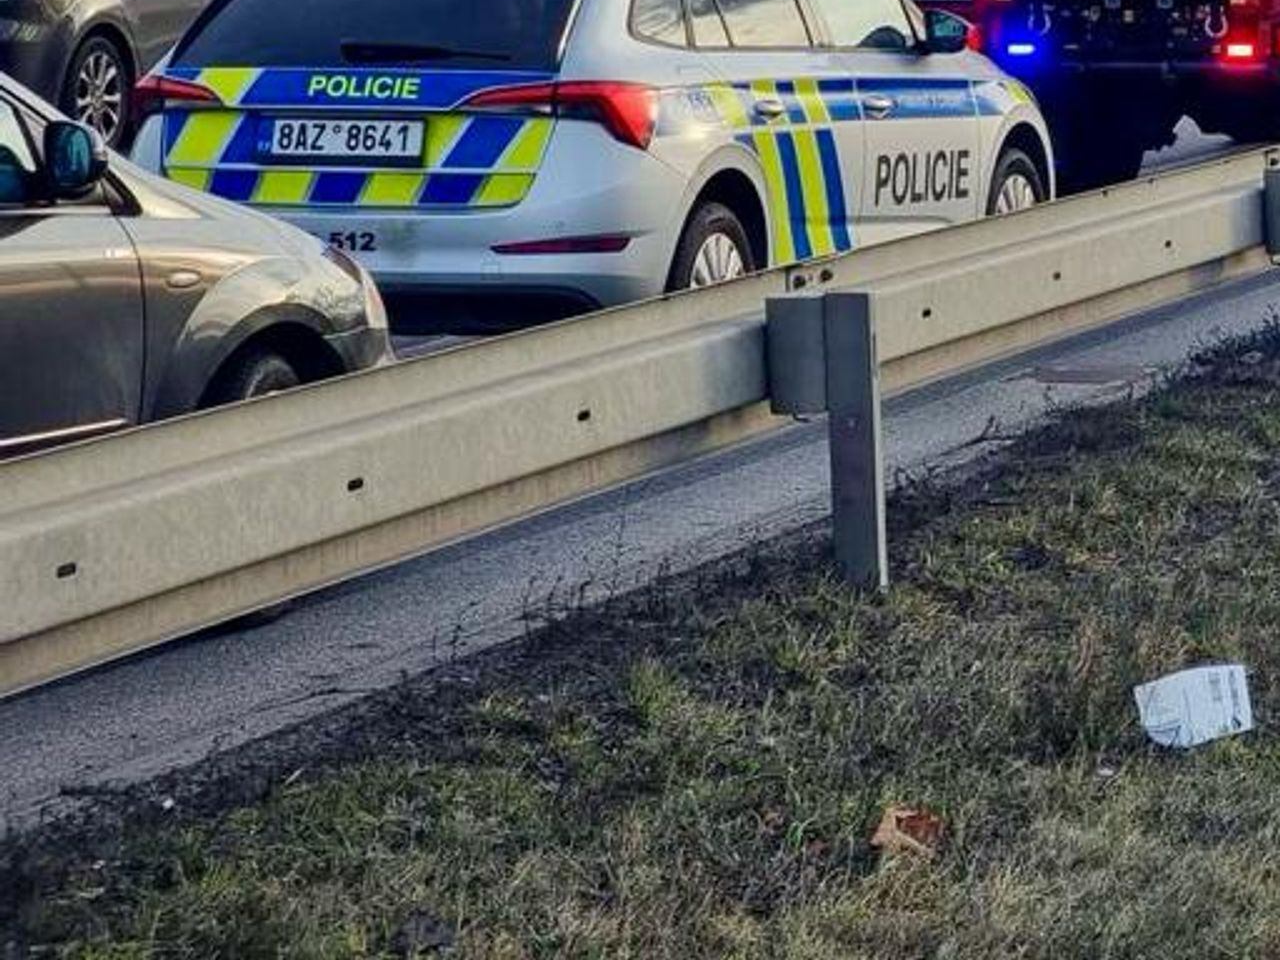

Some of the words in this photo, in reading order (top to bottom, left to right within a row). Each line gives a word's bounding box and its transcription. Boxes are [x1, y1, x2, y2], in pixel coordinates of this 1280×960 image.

[308, 75, 421, 99] POLICIE
[278, 123, 326, 151] 8AZ
[345, 124, 410, 152] 8641
[875, 149, 970, 207] POLICIE
